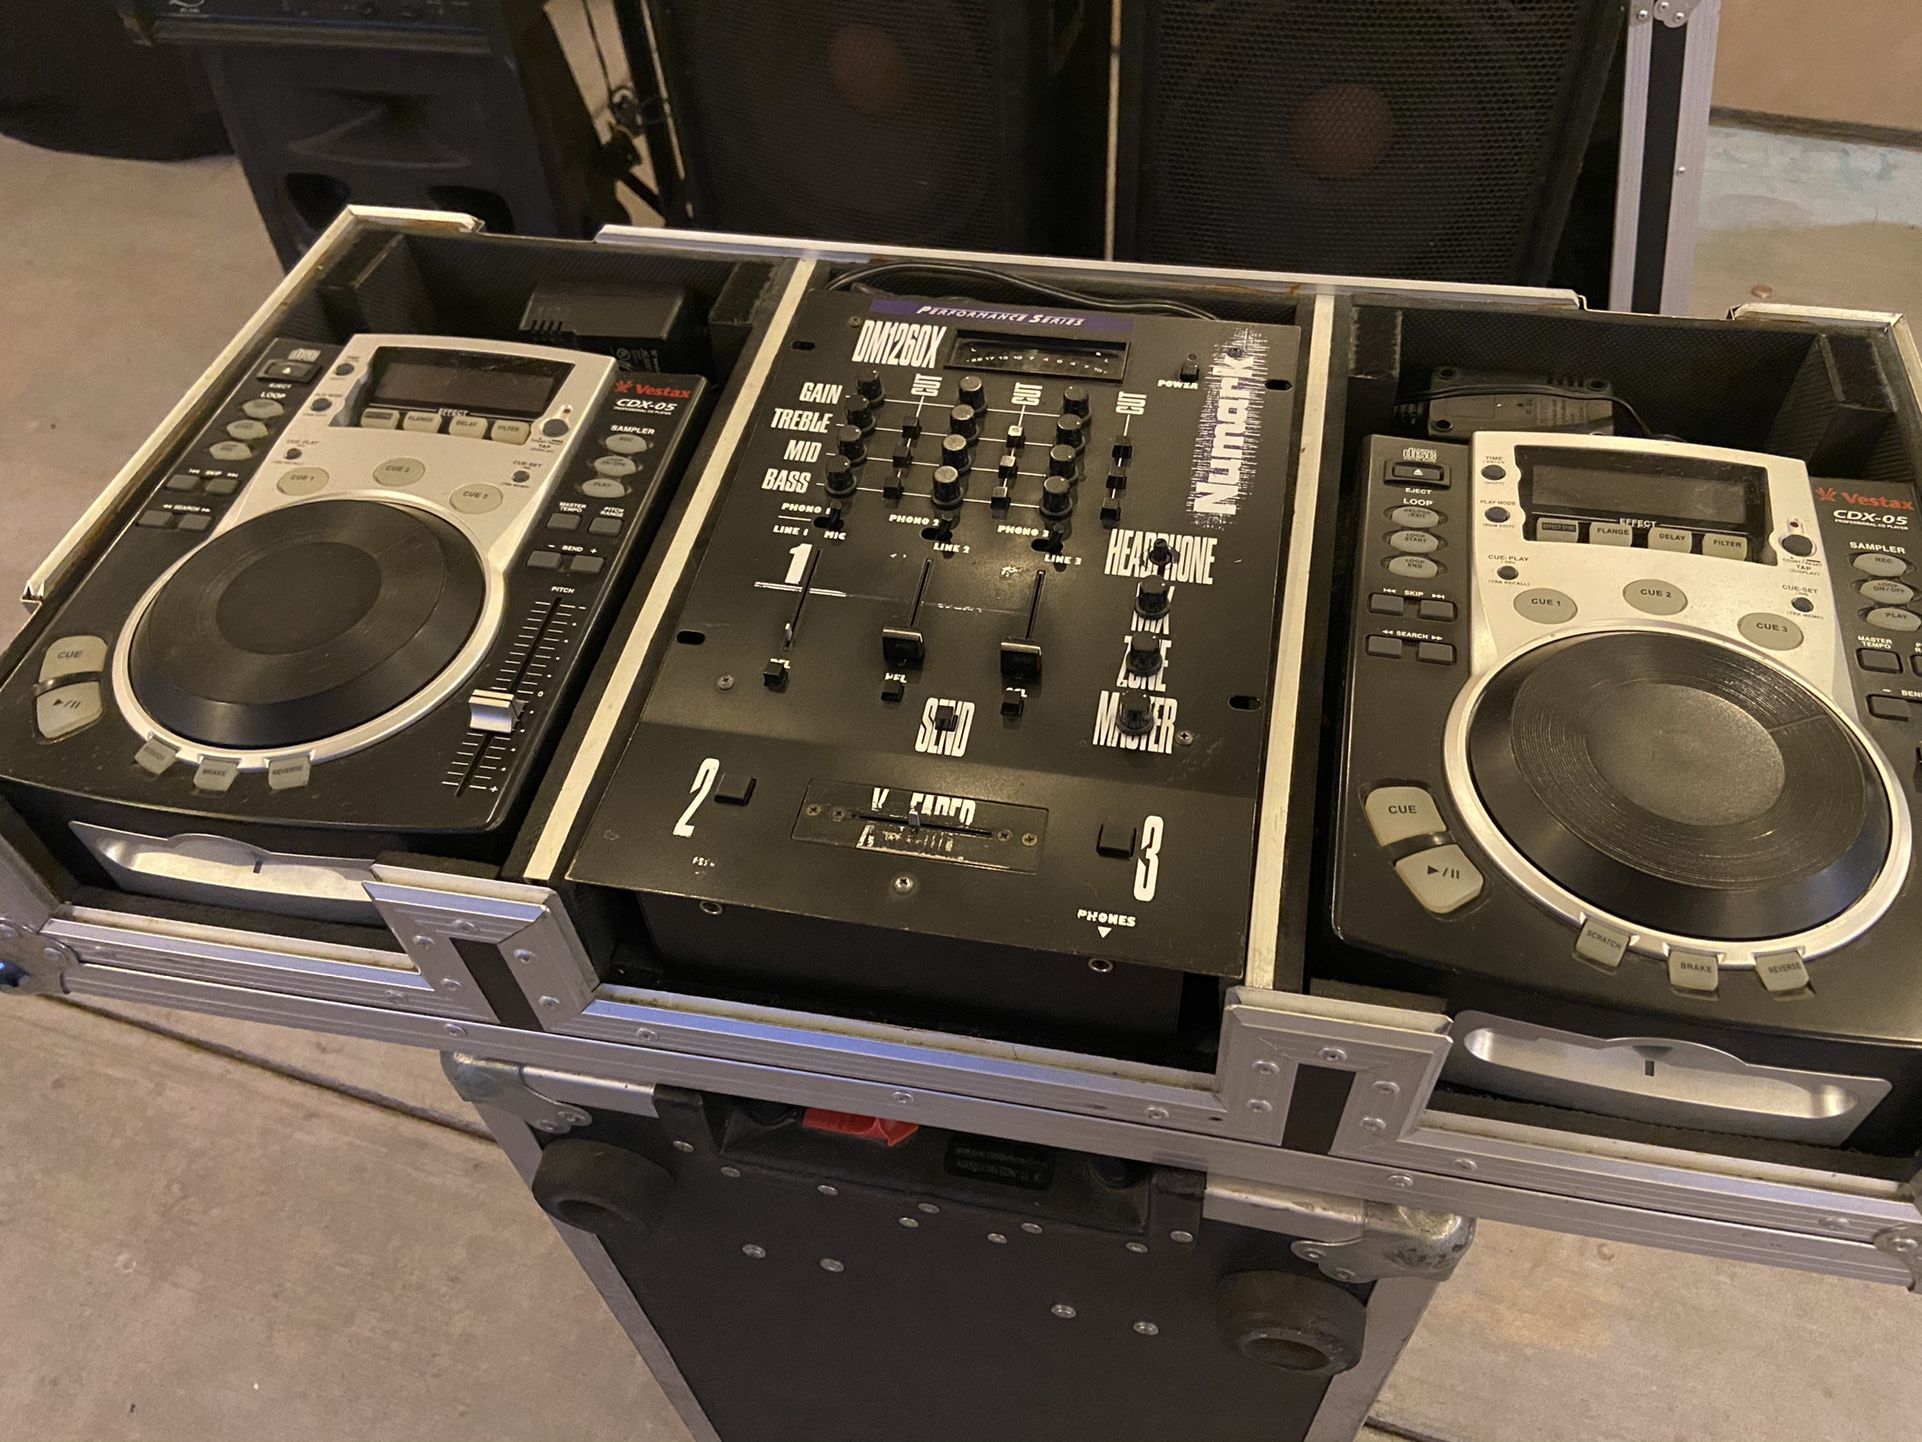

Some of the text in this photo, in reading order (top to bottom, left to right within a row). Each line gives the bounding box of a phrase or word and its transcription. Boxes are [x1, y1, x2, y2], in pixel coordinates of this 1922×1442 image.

[917, 305, 1086, 327] PERFORMANCE SERIES
[852, 320, 947, 369] DM1260X
[635, 384, 692, 399] Vestax
[911, 374, 942, 397] CUT
[260, 391, 287, 399] LOOP
[799, 382, 843, 405] GAIN
[1011, 382, 1043, 406] CUT
[616, 398, 678, 412] CDX-05
[1115, 391, 1147, 415] CUT
[770, 408, 833, 433] TREBLE
[610, 424, 656, 436] SAMPLER
[1192, 350, 1256, 516] Numark
[783, 440, 822, 463] MID
[761, 468, 811, 494] BASS
[462, 490, 481, 499] CUE
[1405, 487, 1432, 495] EJECT
[559, 501, 587, 509] MASTER
[1403, 498, 1433, 507] LOOP
[1841, 492, 1915, 511] Vestax
[781, 502, 822, 515] PHONO
[889, 514, 940, 527] PHONO 2
[1833, 510, 1908, 526] CDX-05
[773, 524, 809, 537] LINE 1
[824, 530, 847, 541] MIC
[997, 525, 1050, 538] PHONO 3
[1597, 527, 1630, 537] FLANGE
[1659, 532, 1686, 541] DELAY
[562, 545, 583, 553] BEND
[933, 543, 970, 554] LINE 2
[1713, 538, 1742, 548] FILTER
[1849, 541, 1906, 554] SAMPLER
[785, 543, 813, 585] 1
[1044, 554, 1082, 565] LINE 3
[551, 586, 576, 594] PITCH
[1640, 588, 1672, 599] CUE 2
[1531, 598, 1553, 606] CUE
[1756, 622, 1779, 632] CUE
[1396, 630, 1429, 640] SEARCH
[1858, 635, 1892, 645] MASTER
[1861, 641, 1892, 650] TEMPO
[57, 650, 82, 660] CUE
[673, 757, 720, 838] 2
[1388, 804, 1417, 815] CUE
[1133, 815, 1164, 902] 3
[1077, 908, 1136, 927] PHONES
[1587, 929, 1622, 949] SCRATCH
[1680, 961, 1713, 974] BRAKE
[1768, 962, 1802, 974] REVERSE
